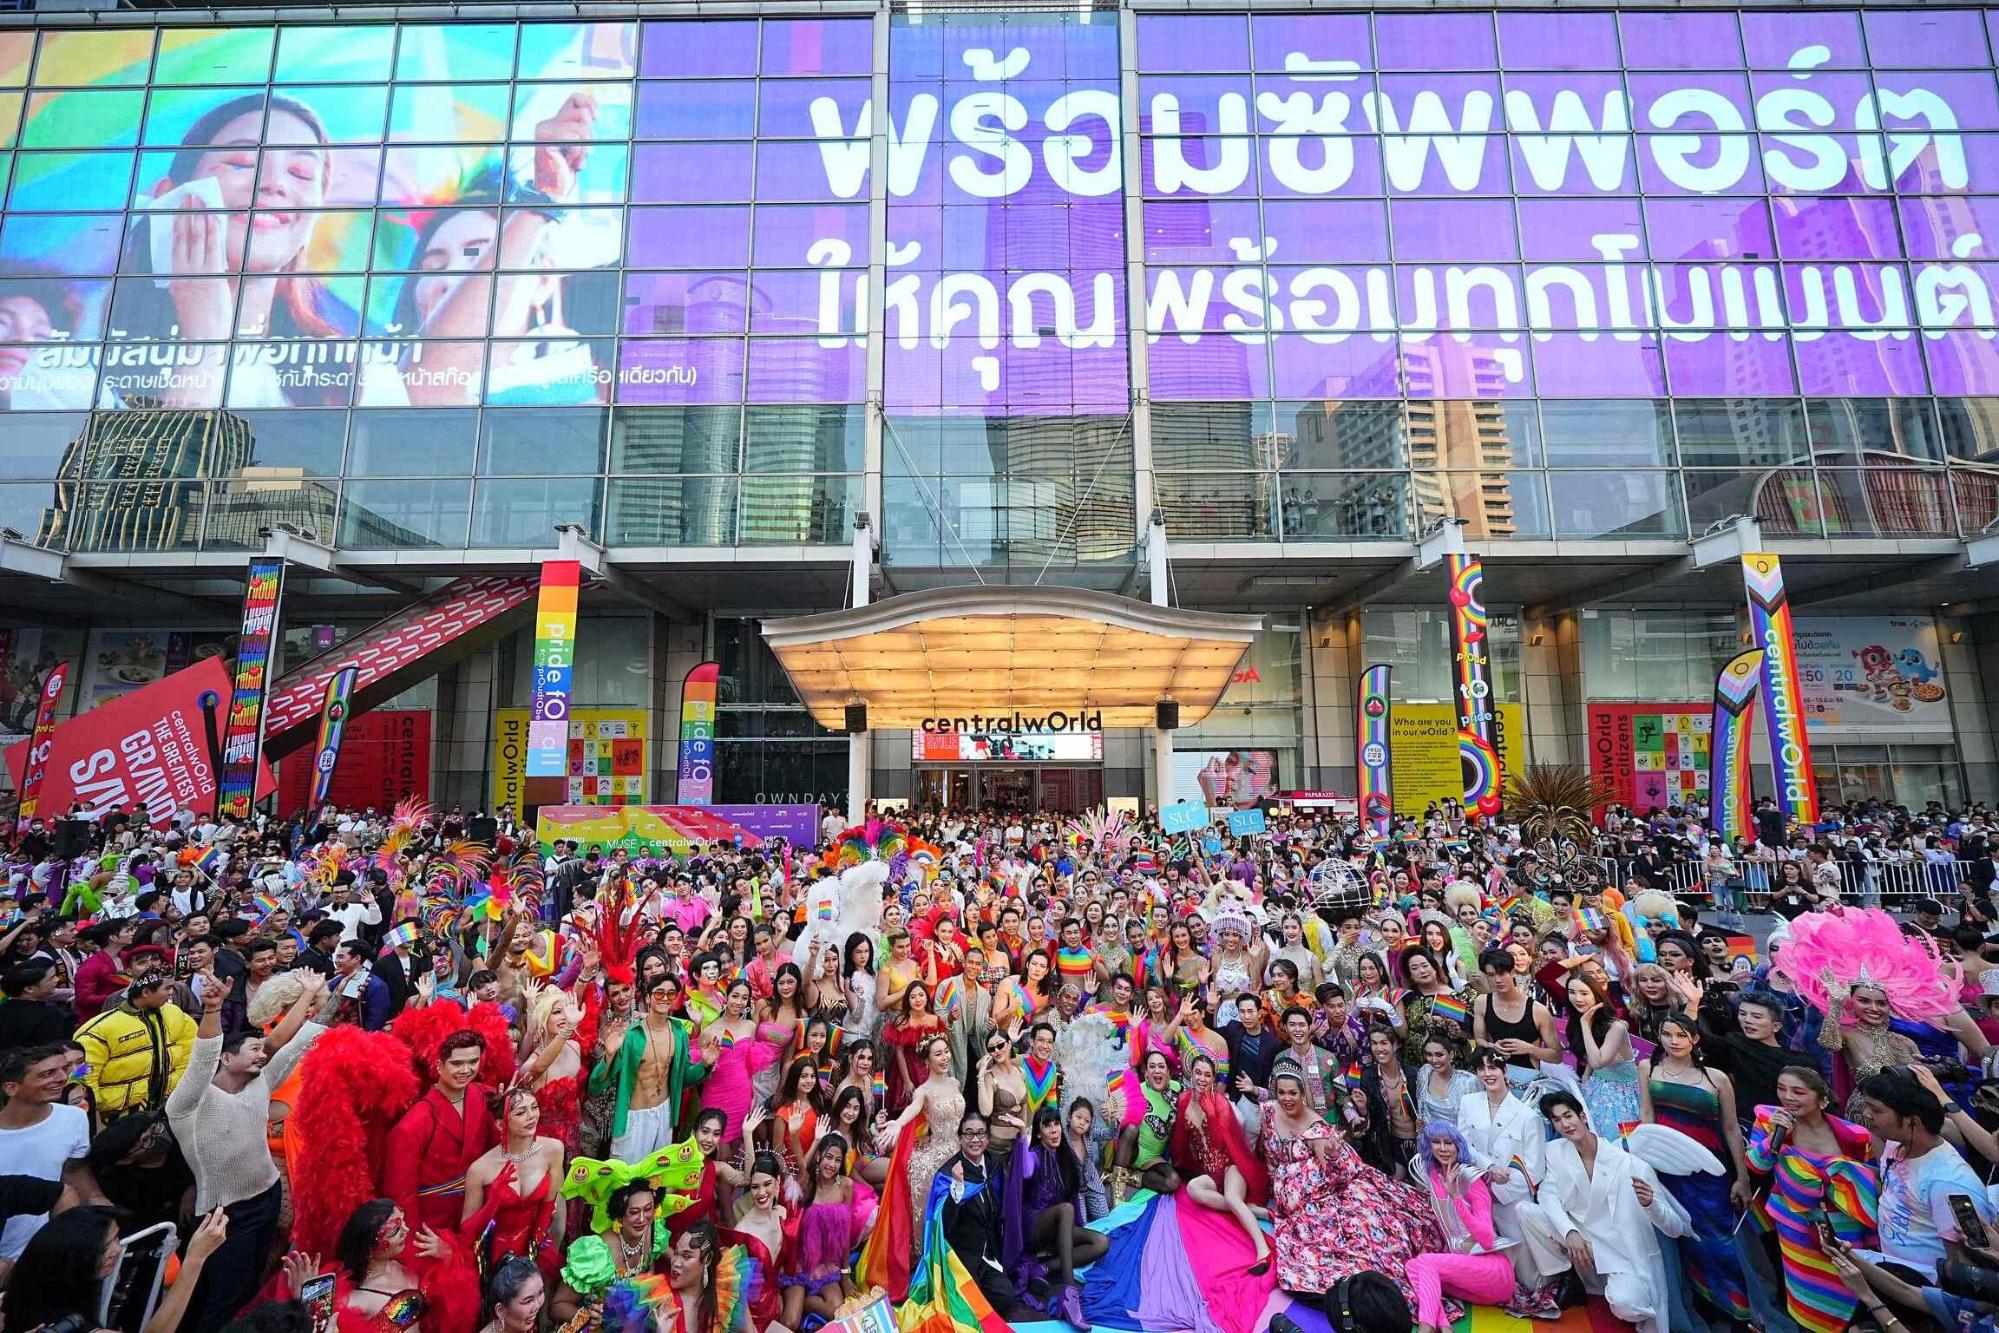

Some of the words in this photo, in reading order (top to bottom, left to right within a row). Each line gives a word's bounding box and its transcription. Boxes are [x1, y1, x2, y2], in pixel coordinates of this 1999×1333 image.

[544, 623, 569, 684] pride
[1805, 669, 1824, 682] 50
[1835, 669, 1853, 682] 20
[921, 710, 1102, 733] centralwOrld
[1394, 718, 1415, 726] Who
[1434, 719, 1451, 728] you
[1460, 711, 1493, 727] pride
[1764, 628, 1809, 802] centralwOrld
[152, 716, 169, 745] THE
[1420, 727, 1448, 736] wOrld
[171, 709, 216, 796] centralwOrld
[540, 736, 562, 766] all
[1617, 714, 1631, 777] citizens
[1233, 812, 1259, 827] SLC
[649, 836, 719, 848] centralwOrld
